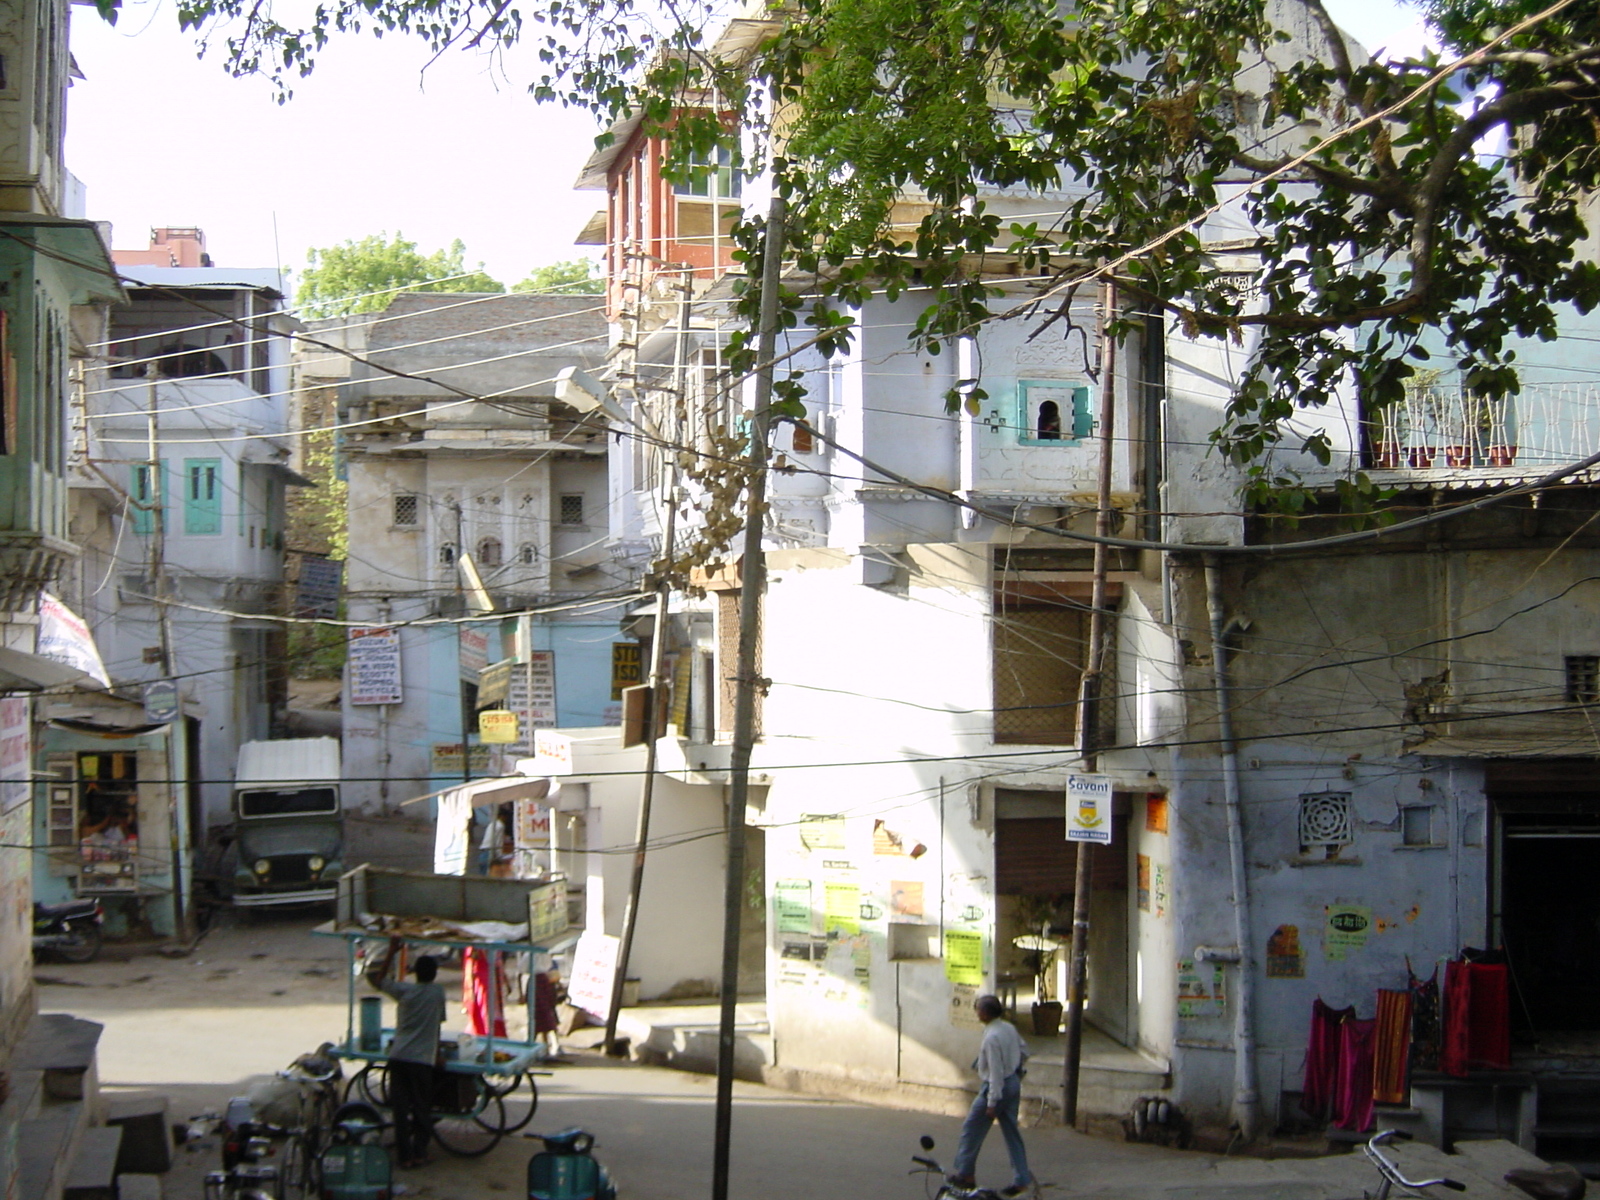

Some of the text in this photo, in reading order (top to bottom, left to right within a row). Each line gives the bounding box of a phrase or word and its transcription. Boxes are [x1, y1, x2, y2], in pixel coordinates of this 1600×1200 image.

[614, 646, 640, 661] STD
[614, 664, 639, 680] ISD
[1068, 775, 1108, 792] Savant
